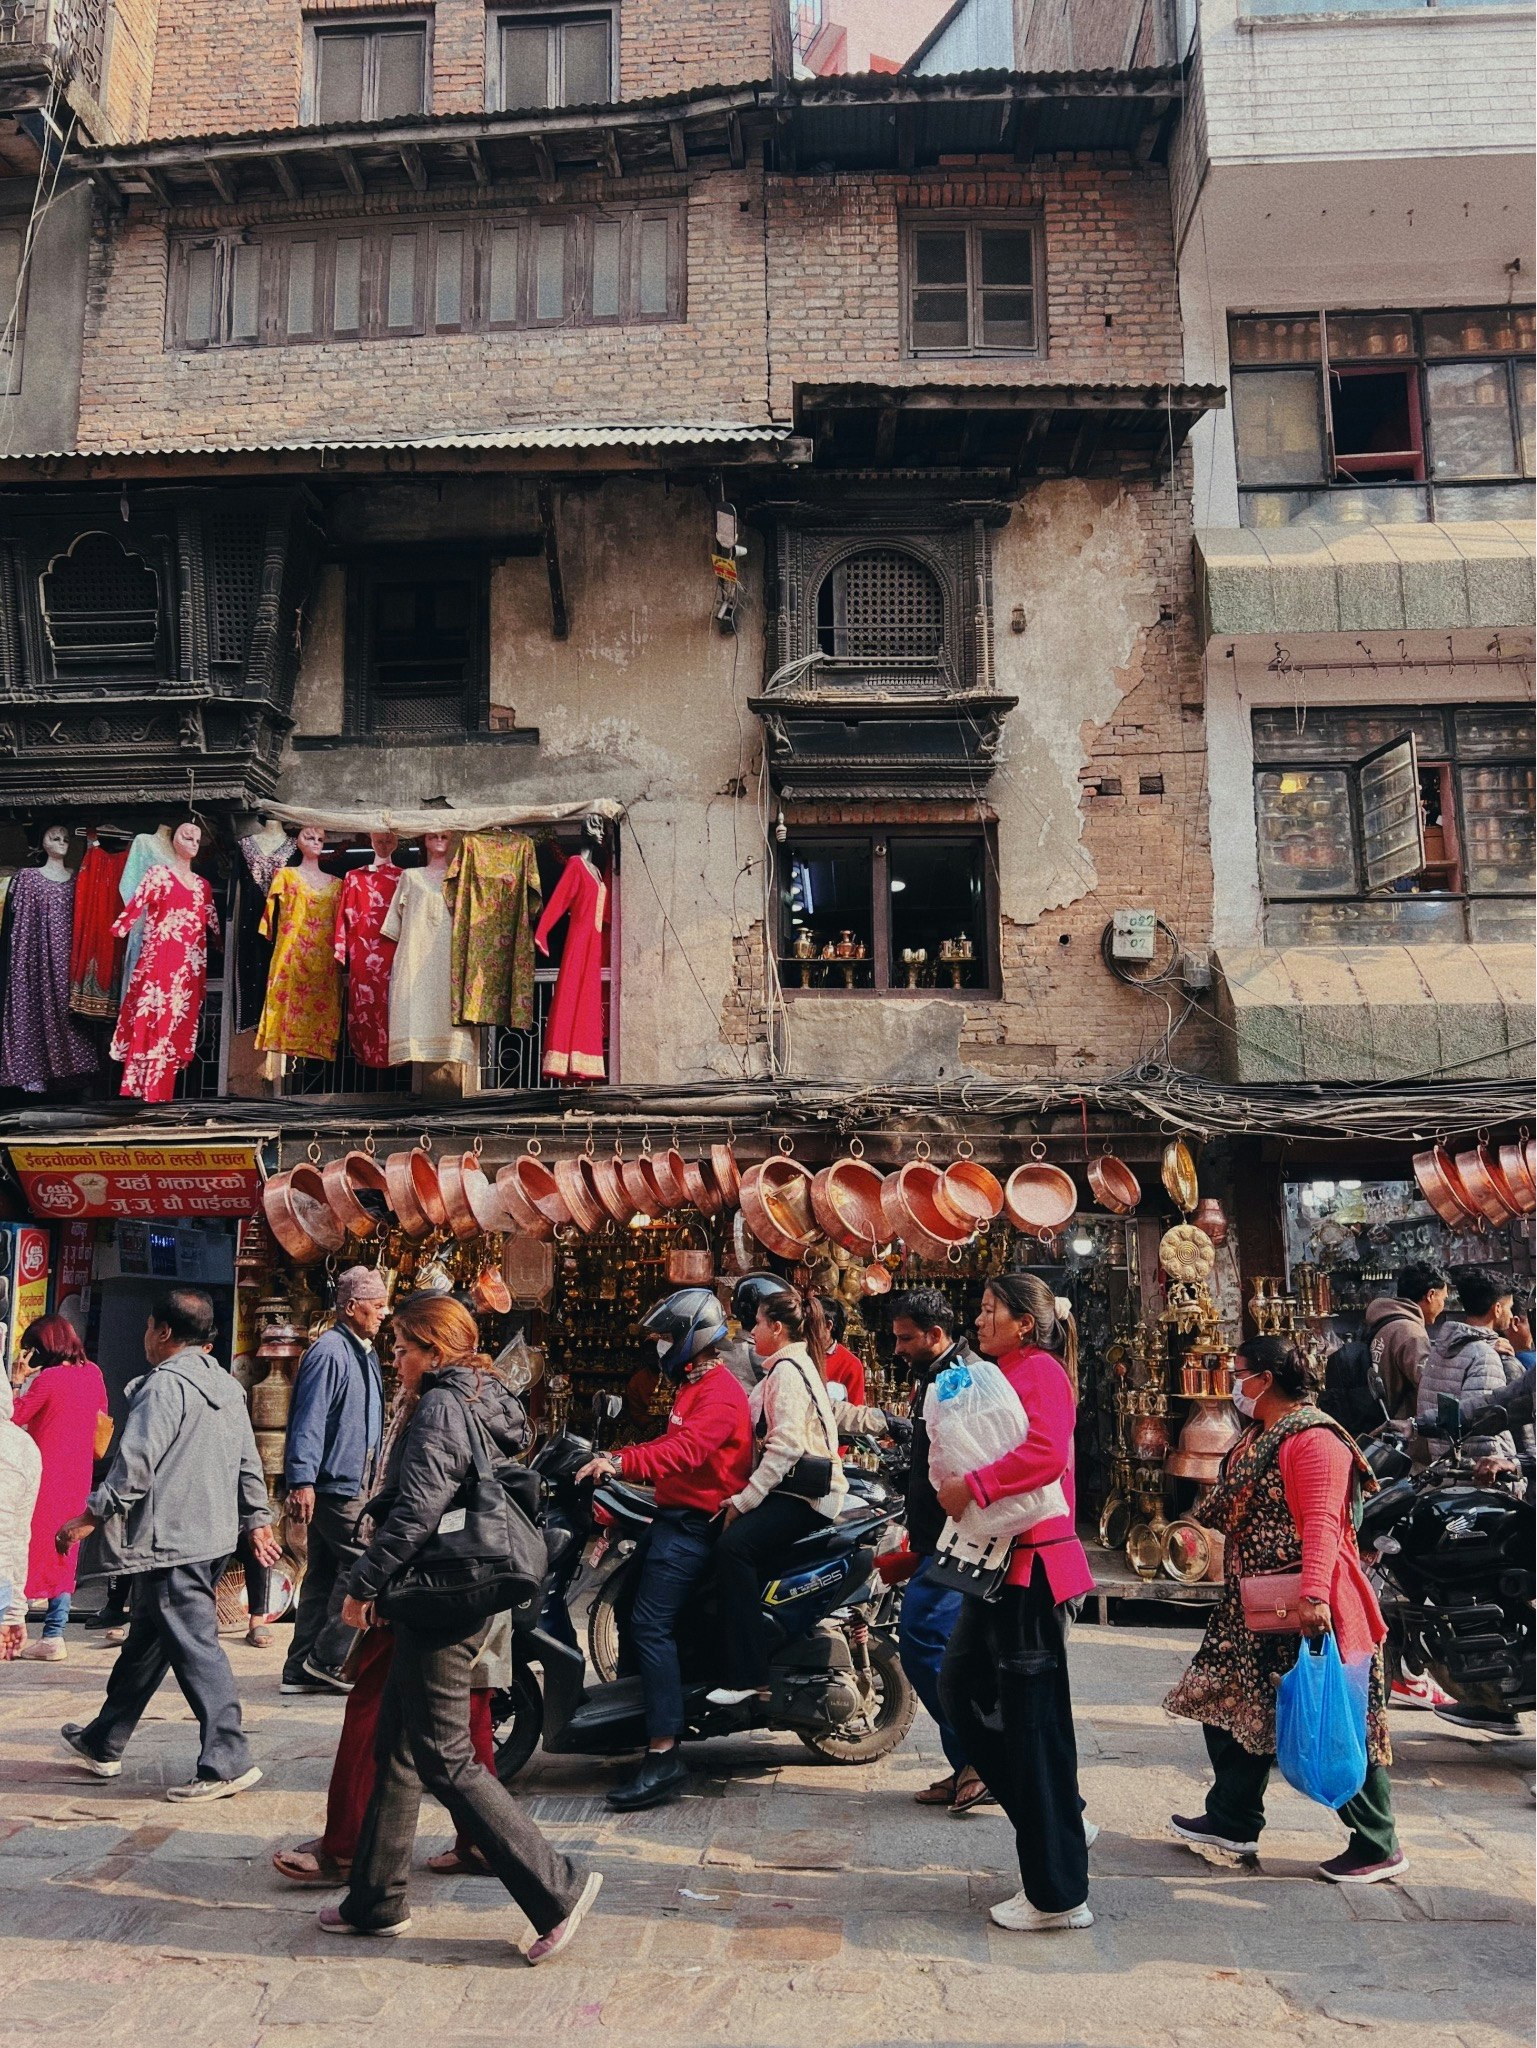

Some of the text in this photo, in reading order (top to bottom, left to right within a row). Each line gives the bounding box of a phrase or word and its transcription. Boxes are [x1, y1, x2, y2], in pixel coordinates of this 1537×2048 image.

[99, 1151, 131, 1166] चिसो
[134, 1151, 166, 1166] मिठो
[169, 1151, 207, 1166] लस्सी
[209, 1153, 246, 1165] पसल
[114, 1173, 247, 1193] यहाँ भक्तपुरको
